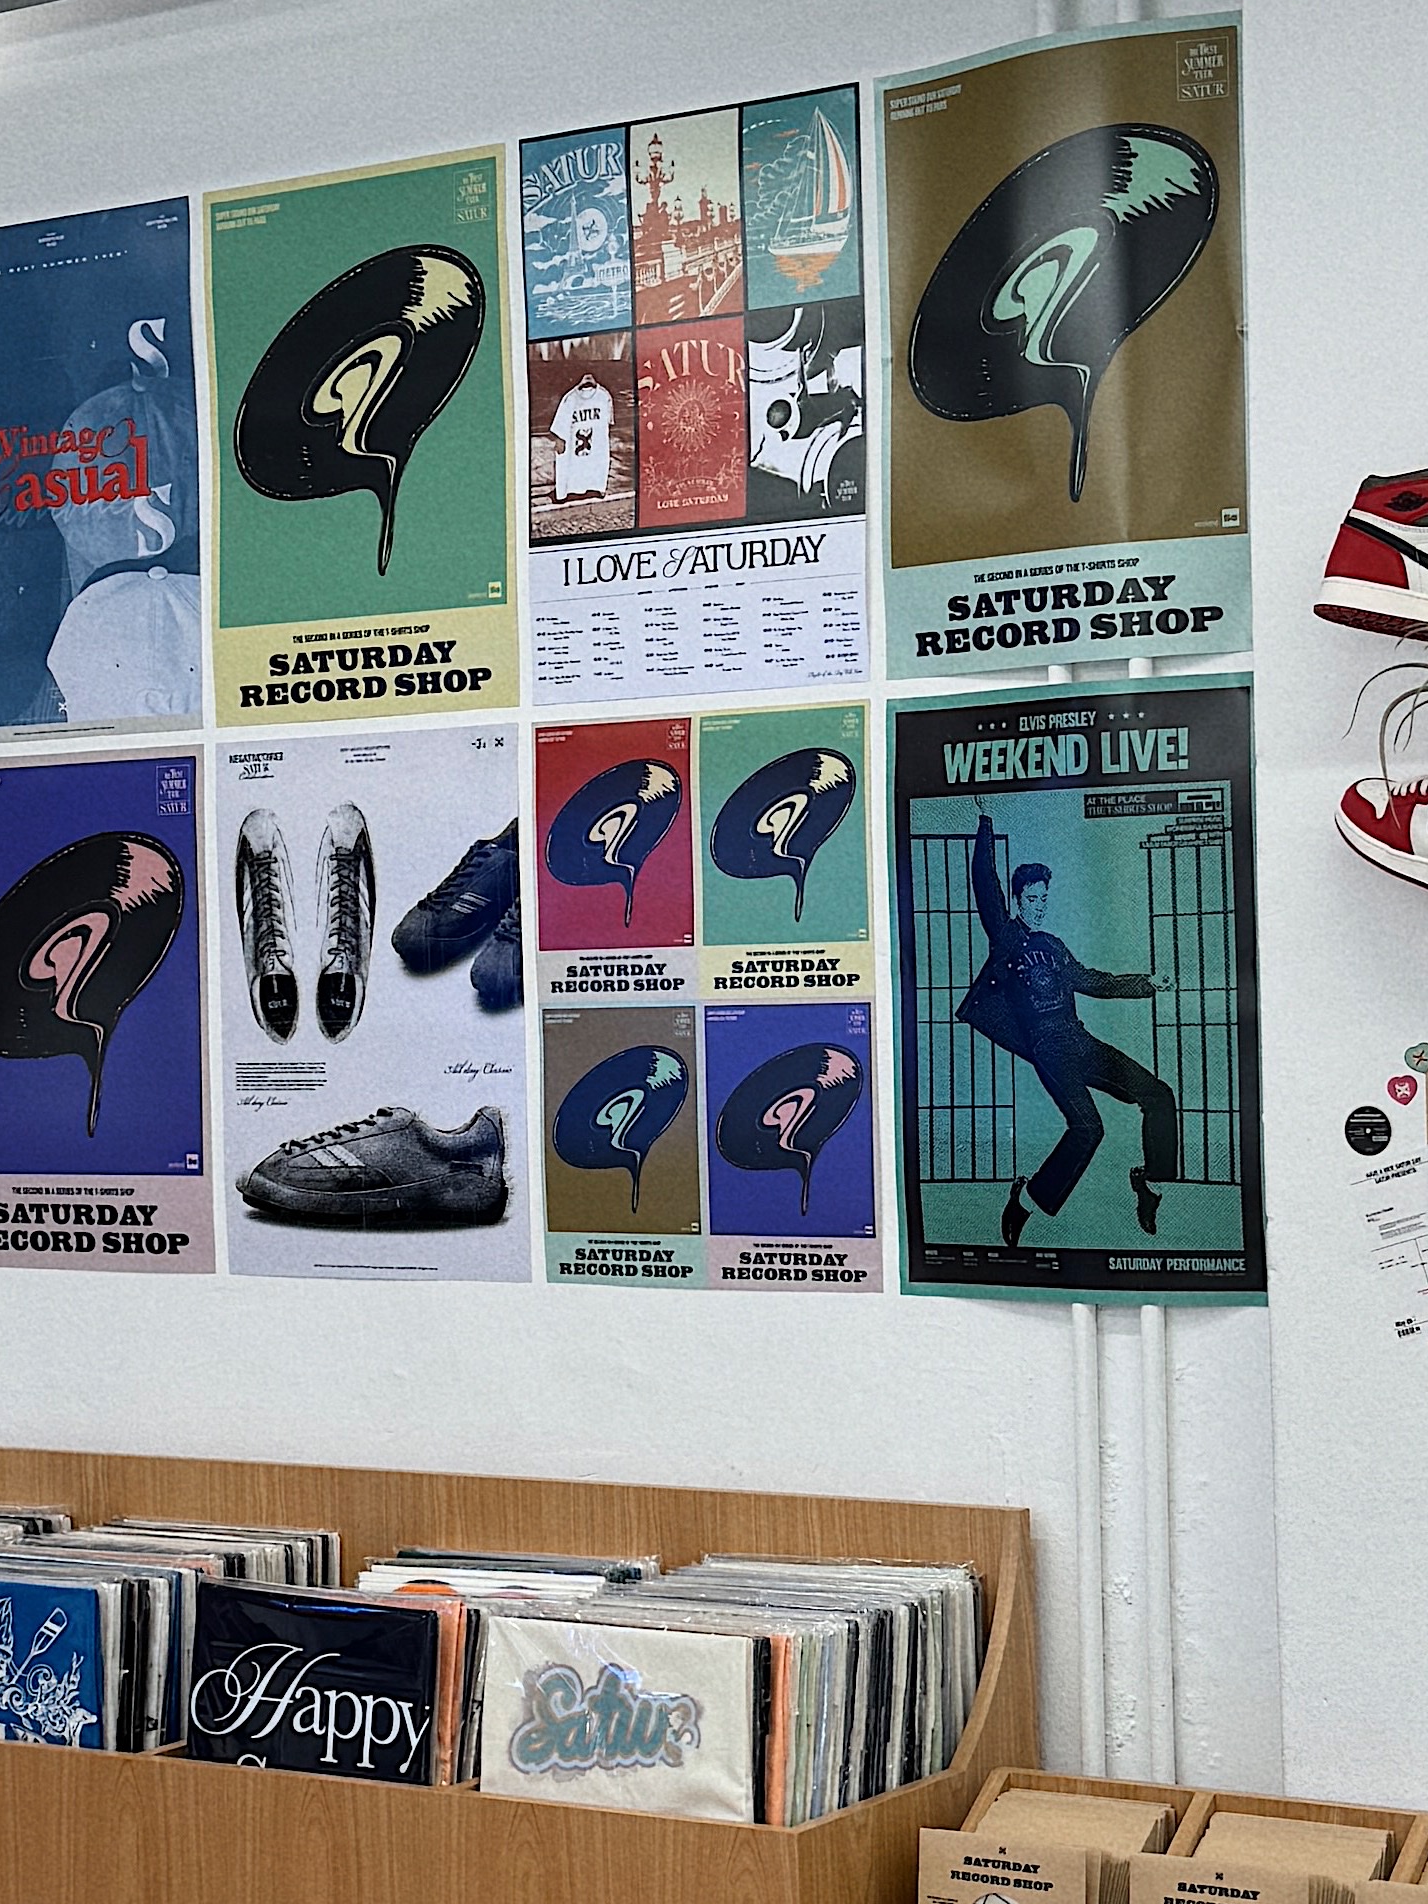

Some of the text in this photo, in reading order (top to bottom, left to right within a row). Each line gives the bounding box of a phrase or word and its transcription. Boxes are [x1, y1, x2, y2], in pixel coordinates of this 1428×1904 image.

[1181, 83, 1225, 99] SATUR
[521, 142, 623, 213] SATUR
[638, 340, 746, 392] SATUR
[571, 407, 601, 423] SATUR
[563, 534, 827, 587] I LOVE SATURDAY
[948, 575, 1176, 622] SATURDAY
[916, 606, 1224, 657] RECORD SHOP
[269, 640, 457, 677] SATURDAY
[239, 667, 492, 708] RECORD SHOP
[1019, 711, 1097, 731] ELVIS PRESLEY
[944, 727, 1189, 784] WEEKEND LIVE!
[566, 963, 667, 978] SATURDAY
[731, 958, 841, 974] SATURDAY
[551, 977, 685, 993] RECORD SHOP
[714, 973, 860, 990] RECORD SHOP
[102, 1232, 190, 1254] SHOP
[575, 1248, 675, 1263] SATURDAY
[739, 1251, 848, 1267] SATURDAY
[1109, 1257, 1246, 1272] SATURDAY PERFORMANCE
[559, 1262, 693, 1278] RECORD SHOP
[722, 1266, 868, 1283] RECORD SHOP
[191, 1642, 430, 1774] Happy
[511, 1663, 703, 1774] Satur
[963, 1856, 1041, 1875] SATURDAY
[950, 1870, 1054, 1893] RECORD SHOP
[1177, 1882, 1262, 1901] SATURDAY
